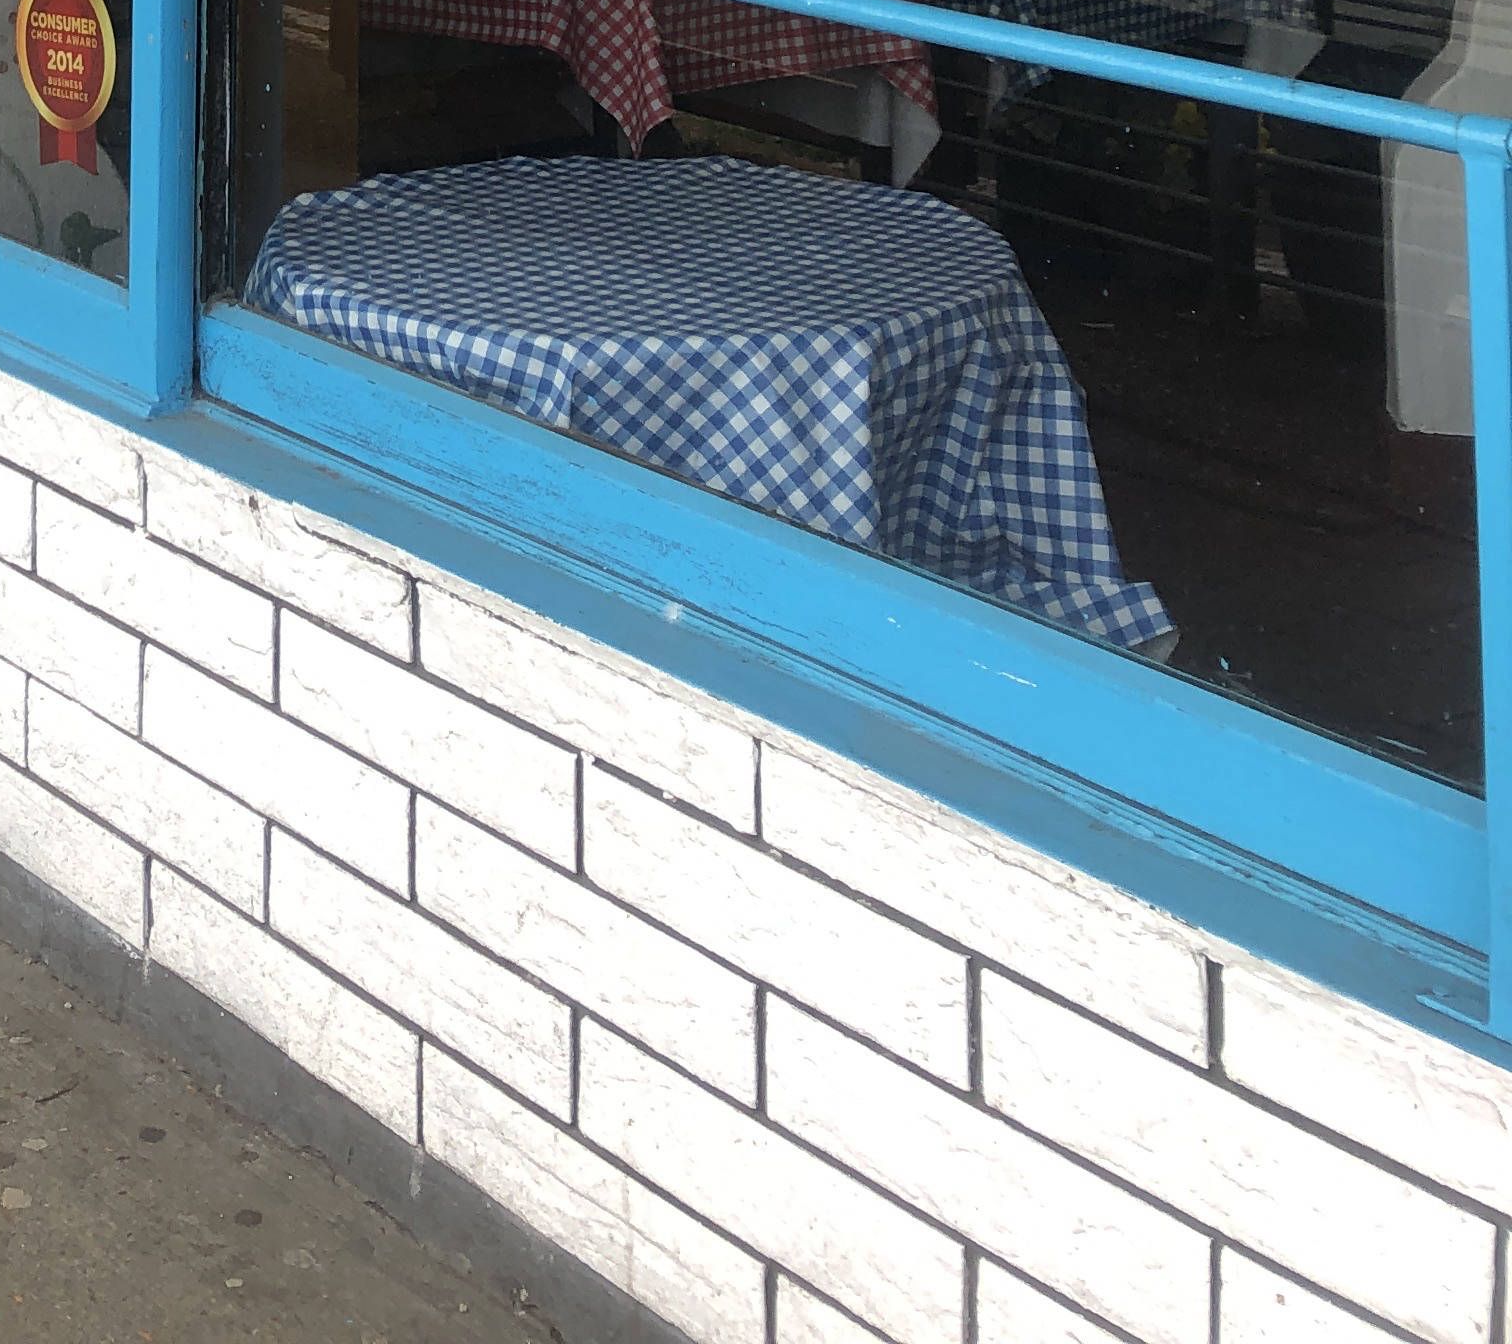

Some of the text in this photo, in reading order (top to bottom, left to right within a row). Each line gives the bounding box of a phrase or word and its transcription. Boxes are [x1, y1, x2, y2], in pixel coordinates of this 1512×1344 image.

[30, 12, 97, 37] CONSUMER
[31, 29, 98, 49] CHOICE AWARD
[47, 49, 85, 75] 2014
[47, 75, 83, 91] BUSINESS
[43, 85, 89, 103] EXCELLENCE
